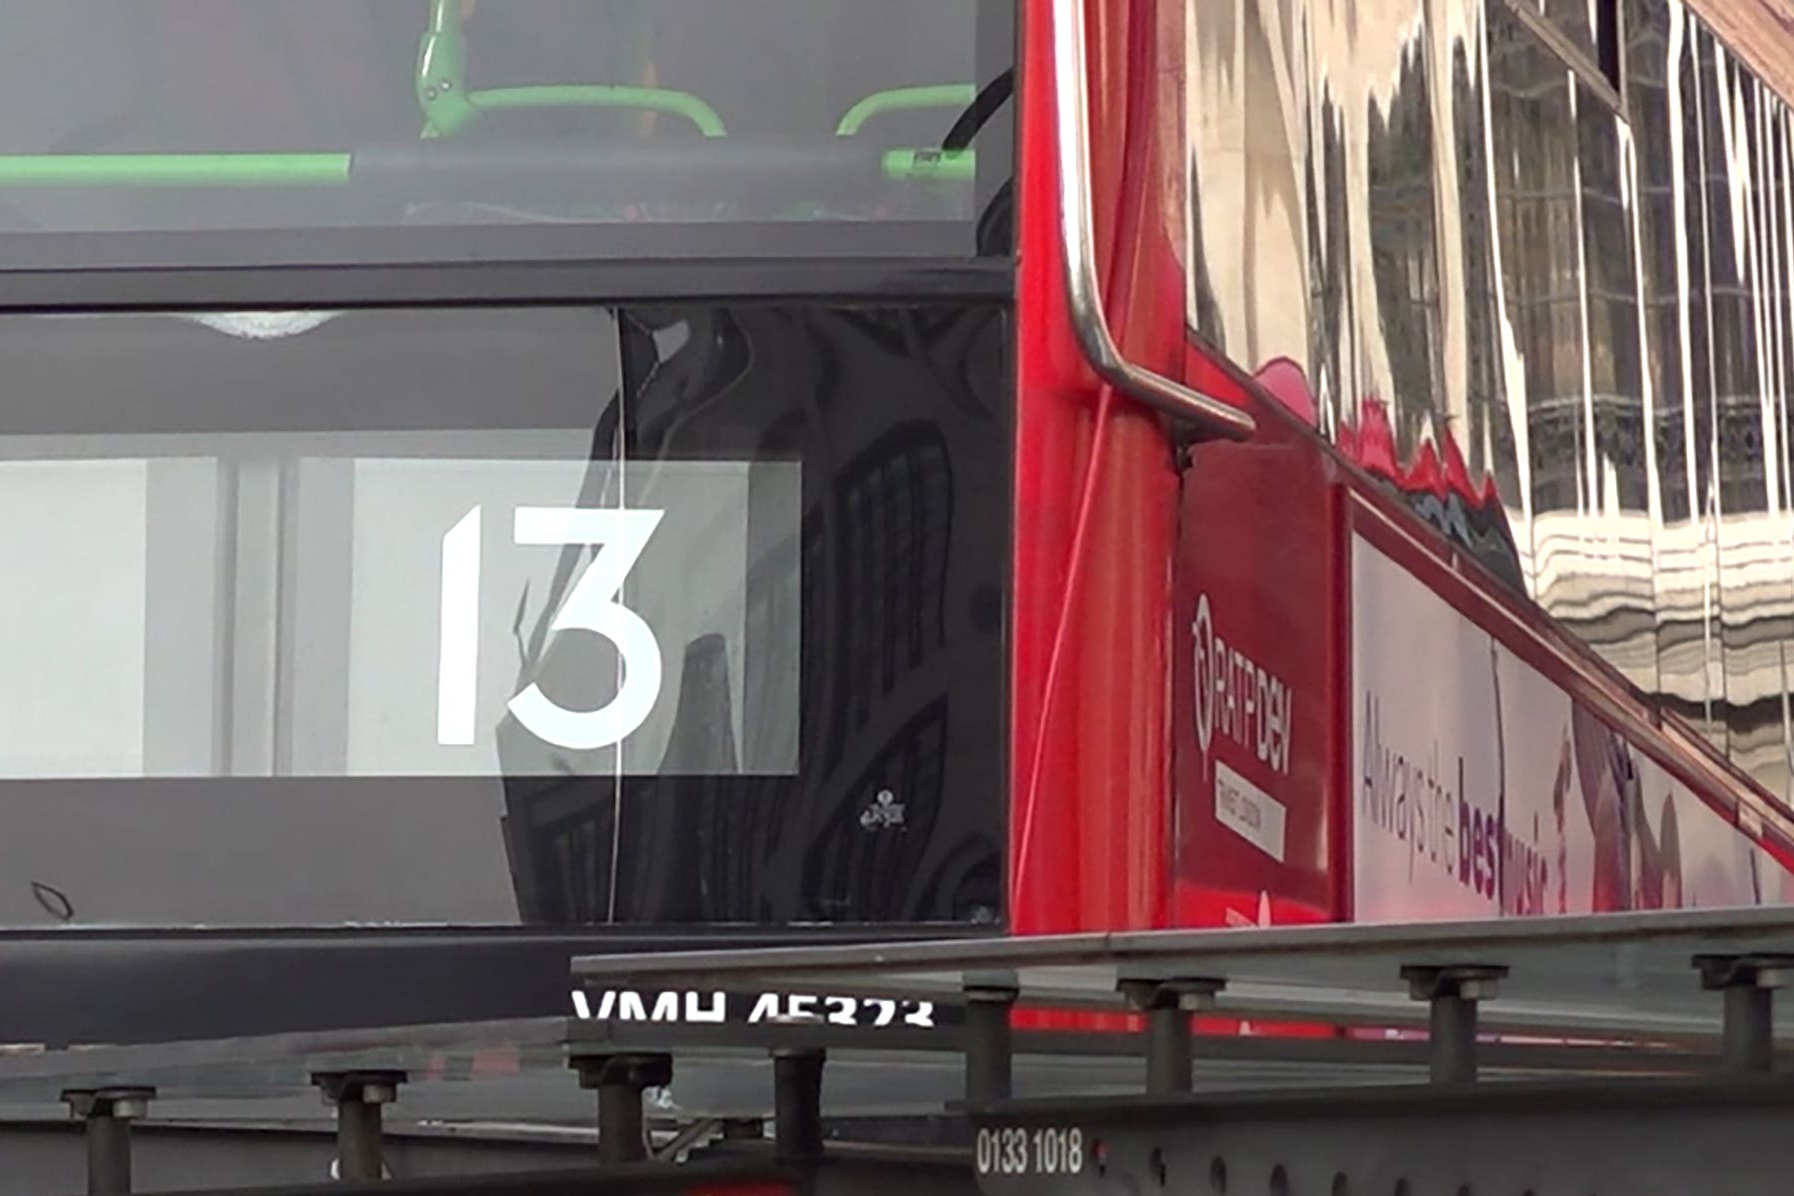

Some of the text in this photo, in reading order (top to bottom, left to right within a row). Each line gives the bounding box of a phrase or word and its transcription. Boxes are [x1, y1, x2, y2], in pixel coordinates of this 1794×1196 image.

[437, 505, 666, 750] 13
[571, 990, 726, 1023] VMH
[977, 1127, 1083, 1174] 0133 1018
